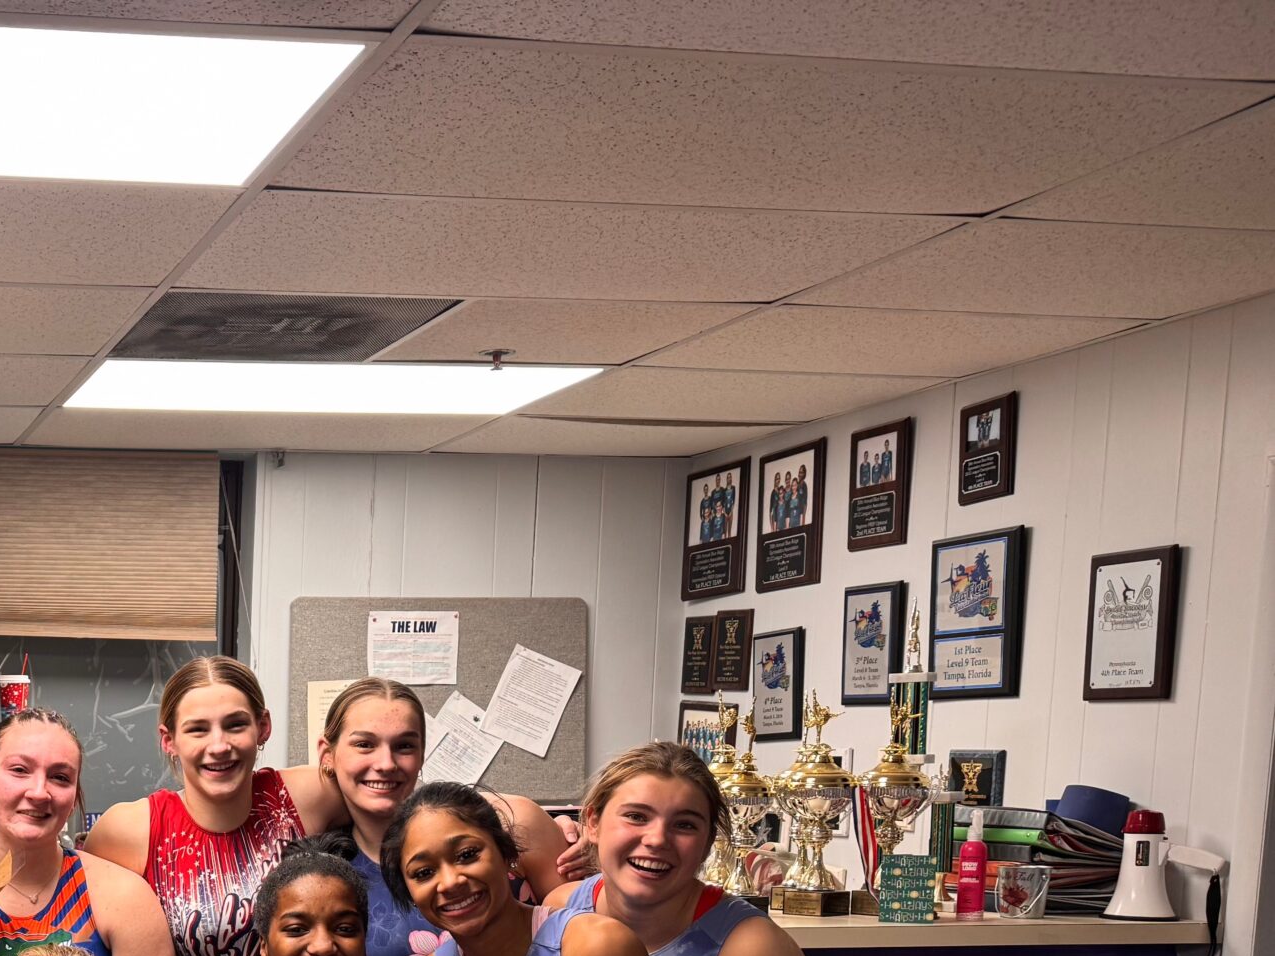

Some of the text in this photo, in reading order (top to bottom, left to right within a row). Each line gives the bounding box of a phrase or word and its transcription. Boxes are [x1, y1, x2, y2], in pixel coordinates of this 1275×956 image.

[391, 621, 437, 633] THE LAW
[955, 645, 982, 655] 1st Place
[863, 656, 878, 664] Place
[947, 658, 963, 668] Level
[970, 657, 988, 666] Team
[943, 669, 991, 682] Tampa, Florida
[770, 696, 782, 704] Place
[167, 845, 194, 864] 1776
